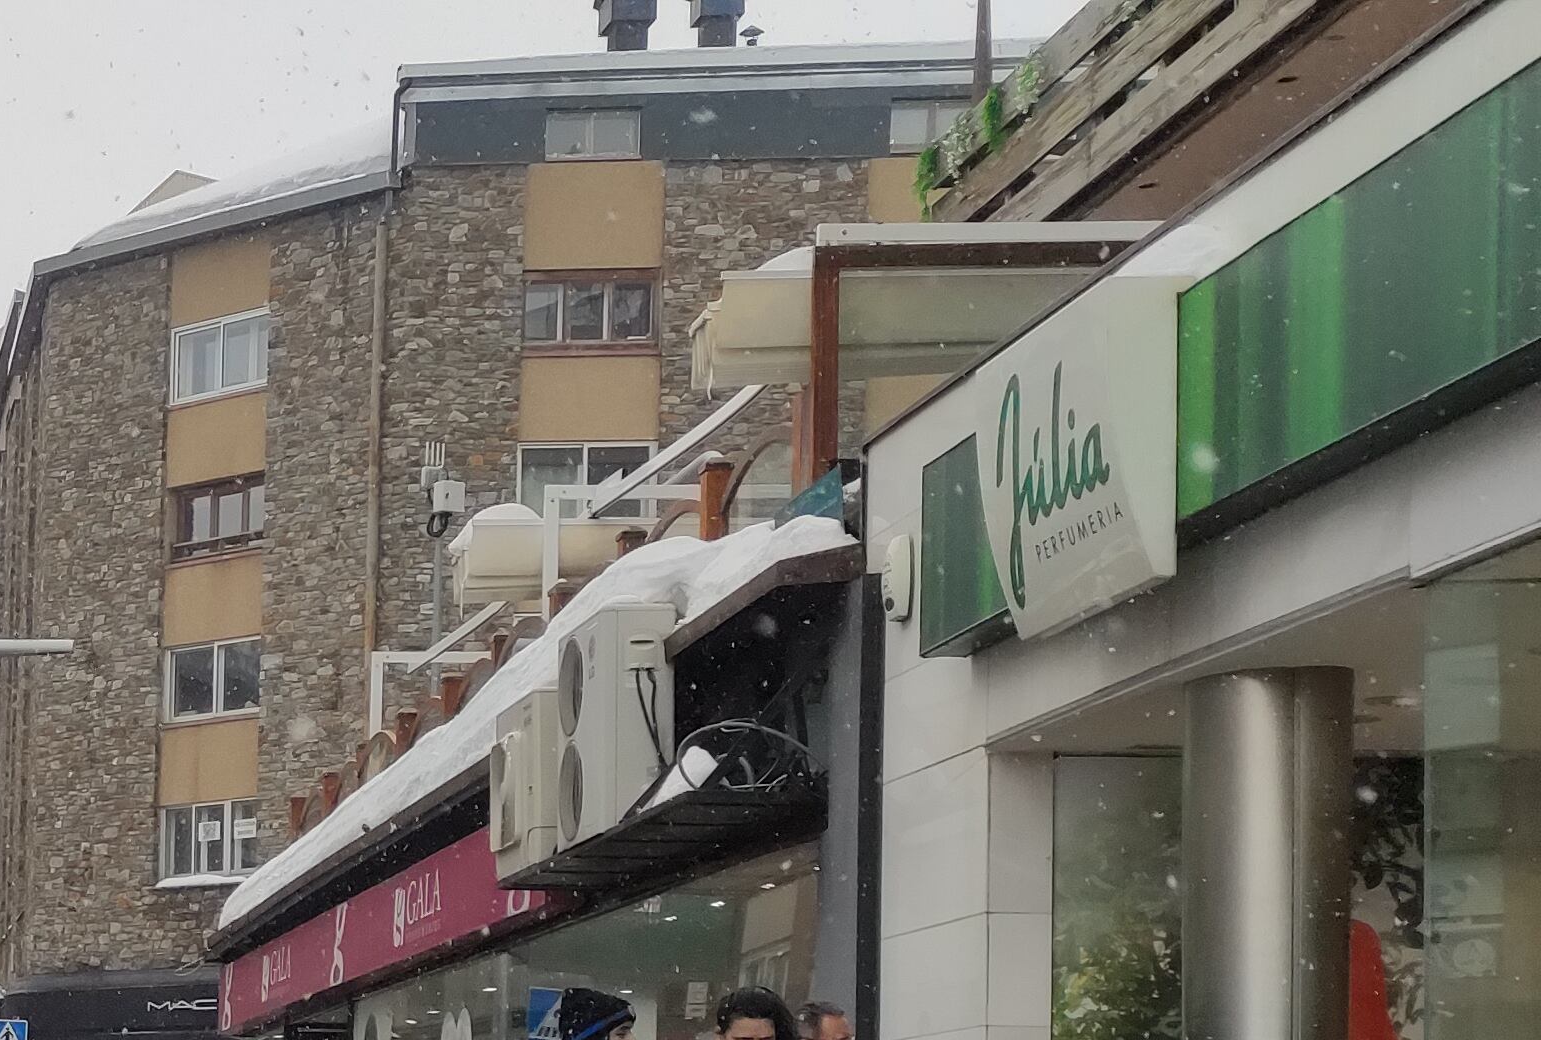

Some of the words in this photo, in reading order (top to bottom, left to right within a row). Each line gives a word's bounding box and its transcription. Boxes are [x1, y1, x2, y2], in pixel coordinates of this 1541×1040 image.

[995, 359, 1110, 611] Júlia
[1034, 501, 1123, 563] PERFUMERIA
[405, 868, 442, 927] GALA
[270, 944, 291, 985] GALA
[147, 998, 217, 1012] MAC
